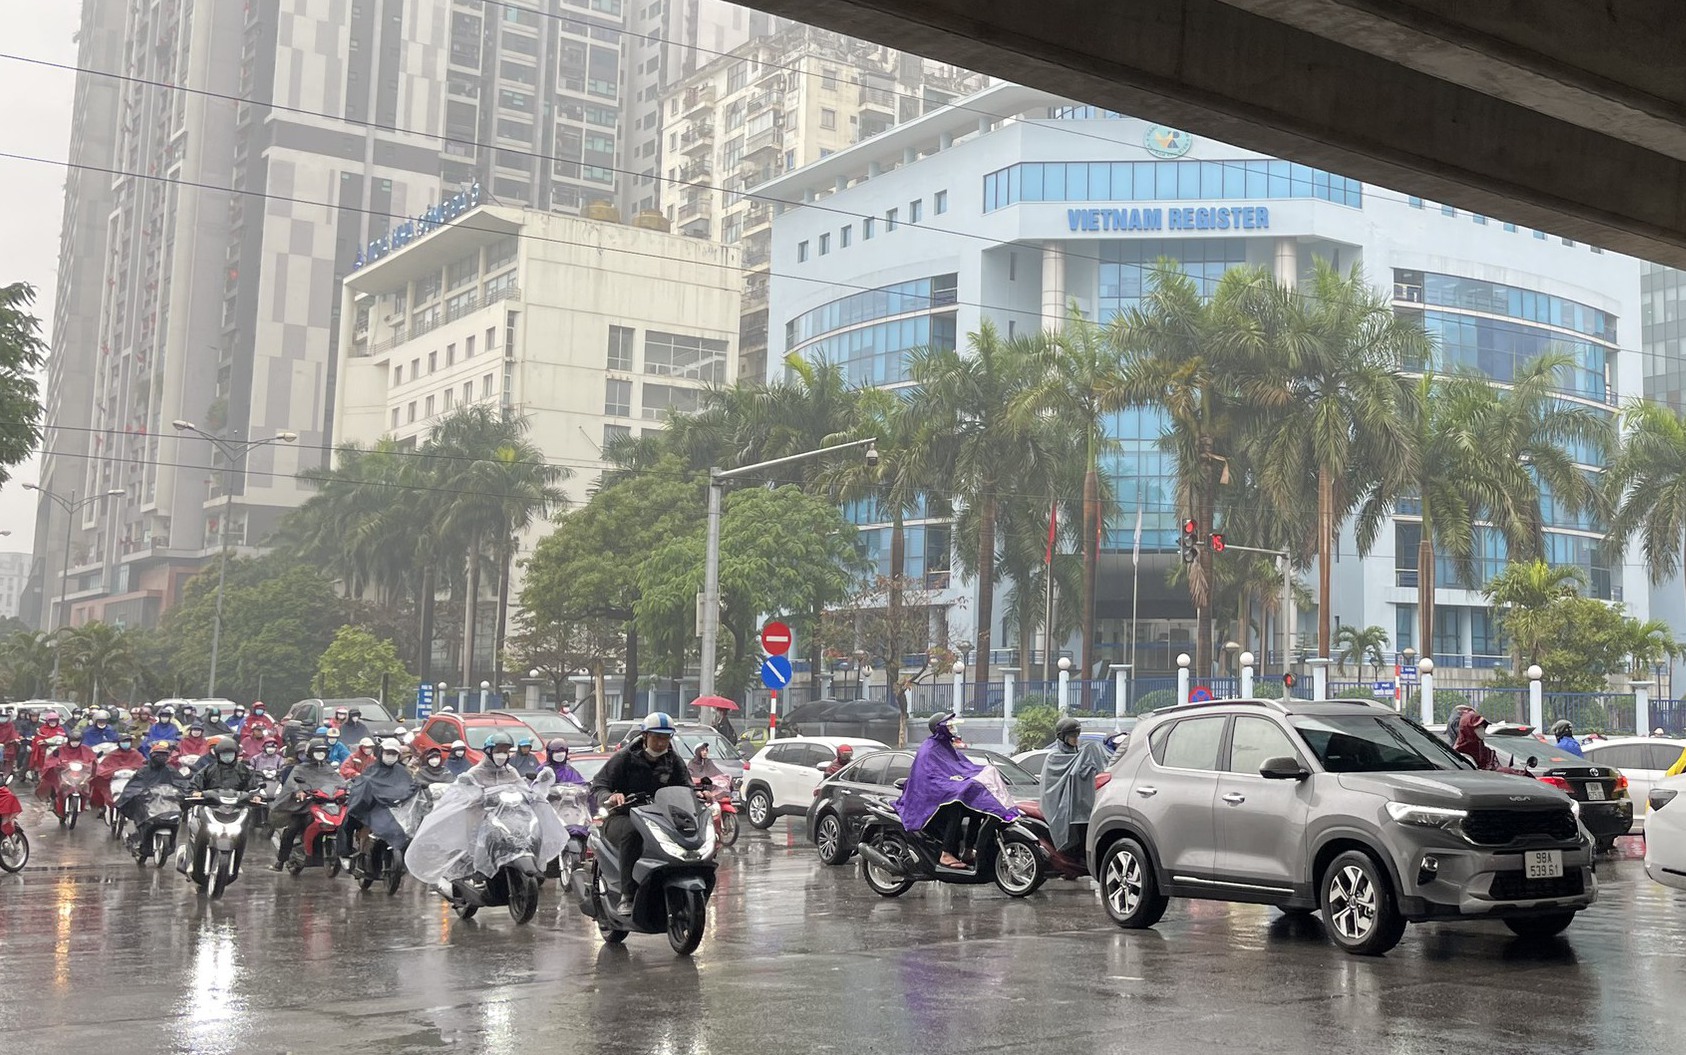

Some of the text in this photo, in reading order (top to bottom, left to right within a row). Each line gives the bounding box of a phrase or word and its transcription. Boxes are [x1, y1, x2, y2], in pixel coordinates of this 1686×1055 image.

[1067, 206, 1270, 231] VIETNAM REGISTER
[1535, 852, 1552, 864] 98A
